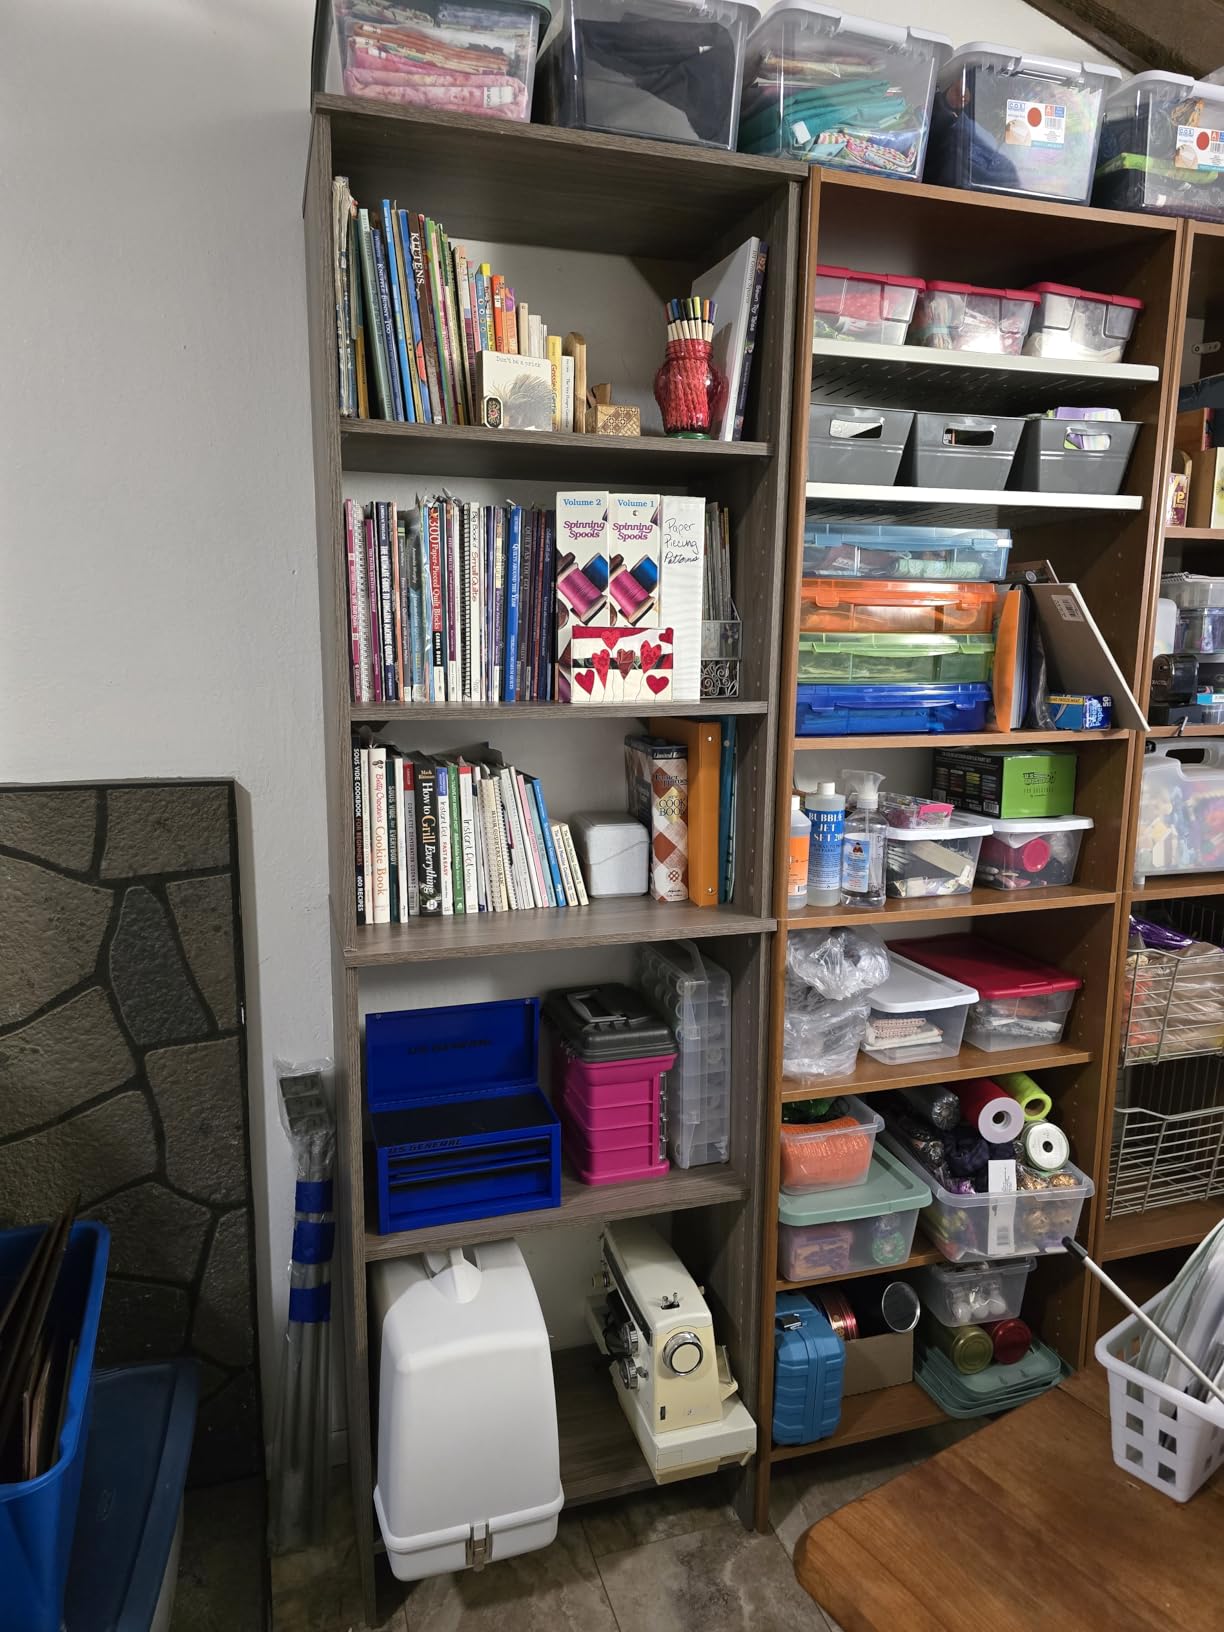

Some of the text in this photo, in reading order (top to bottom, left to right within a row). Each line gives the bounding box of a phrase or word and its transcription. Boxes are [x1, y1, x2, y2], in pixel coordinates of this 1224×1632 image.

[411, 231, 424, 284] KITTENS
[377, 262, 387, 293] KNUFFLE
[429, 519, 440, 542] 300
[564, 520, 606, 532] Spinning
[612, 523, 653, 534] Spinning
[664, 518, 696, 535] Paper
[568, 530, 600, 540] Spools
[617, 532, 648, 542] Spools
[380, 545, 389, 554] THE
[380, 555, 390, 577] ULTIMATE
[432, 543, 440, 586] Paper-Pieced
[382, 577, 390, 592] GUIDE
[432, 588, 440, 607] Quilt
[384, 623, 392, 644] MACHINE
[384, 644, 394, 665] QUILTING
[1102, 696, 1109, 707] 50
[659, 799, 686, 808] COOK
[659, 808, 686, 816] BOOK
[808, 812, 844, 822] BUBBLE
[374, 773, 387, 895] Betty Crocker's Cookie Book
[464, 818, 473, 849] Instant
[819, 824, 835, 832] JET
[422, 782, 437, 893] How to Grill Everything
[466, 852, 474, 867] Pot
[410, 1138, 463, 1151] GENERAL
